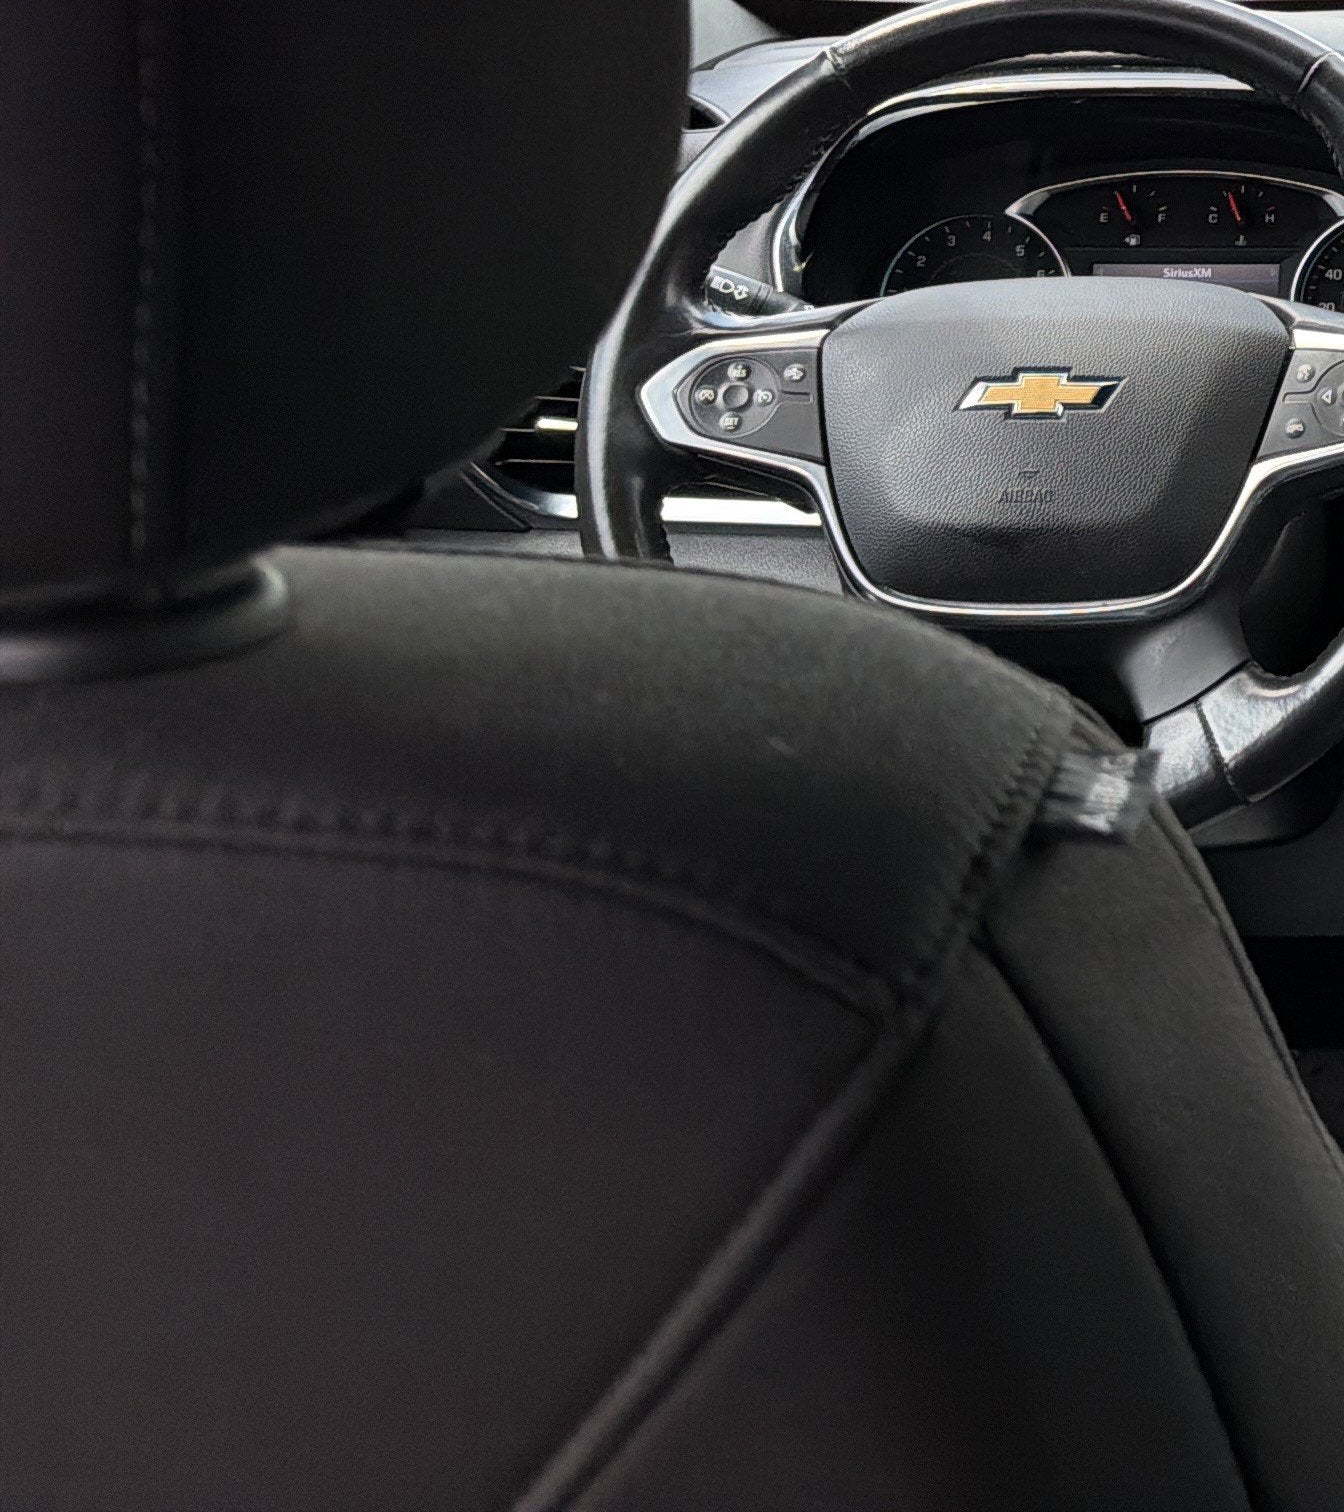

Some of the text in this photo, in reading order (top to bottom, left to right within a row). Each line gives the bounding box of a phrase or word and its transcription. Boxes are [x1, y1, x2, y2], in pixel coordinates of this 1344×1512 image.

[1099, 212, 1109, 223] E
[1157, 213, 1166, 223] F
[1264, 213, 1275, 224] H
[947, 234, 956, 247] 3
[982, 231, 992, 242] 4
[1015, 244, 1025, 257] 5
[916, 255, 927, 267] 2
[1162, 267, 1212, 279] SiriusXM
[1324, 268, 1342, 281] 40
